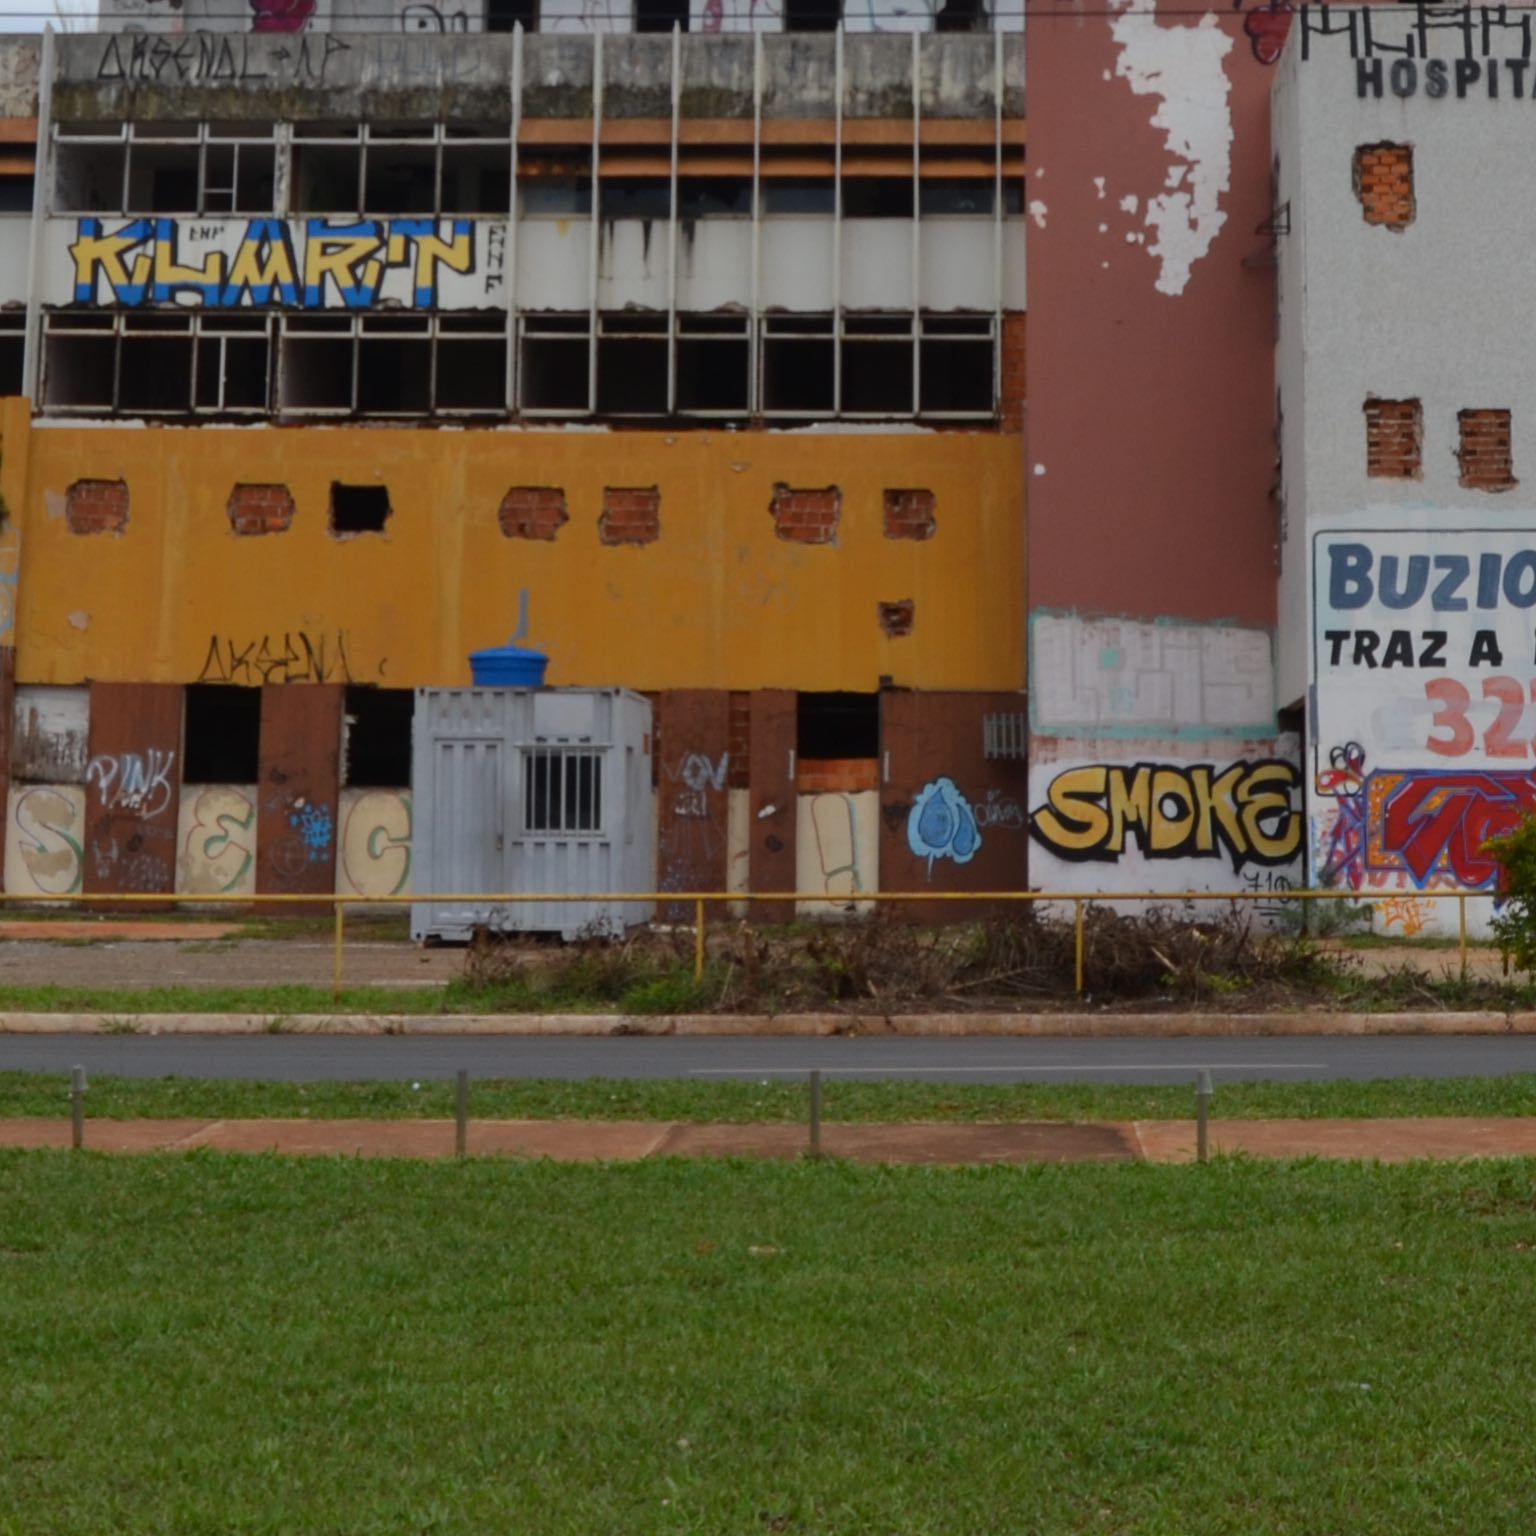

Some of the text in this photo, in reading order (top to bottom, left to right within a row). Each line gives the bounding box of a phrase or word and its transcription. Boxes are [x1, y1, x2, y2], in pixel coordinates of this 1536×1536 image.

[1325, 630, 1448, 668] TRAZ
[1468, 629, 1503, 666] A
[1029, 759, 1303, 872] SMOKE
